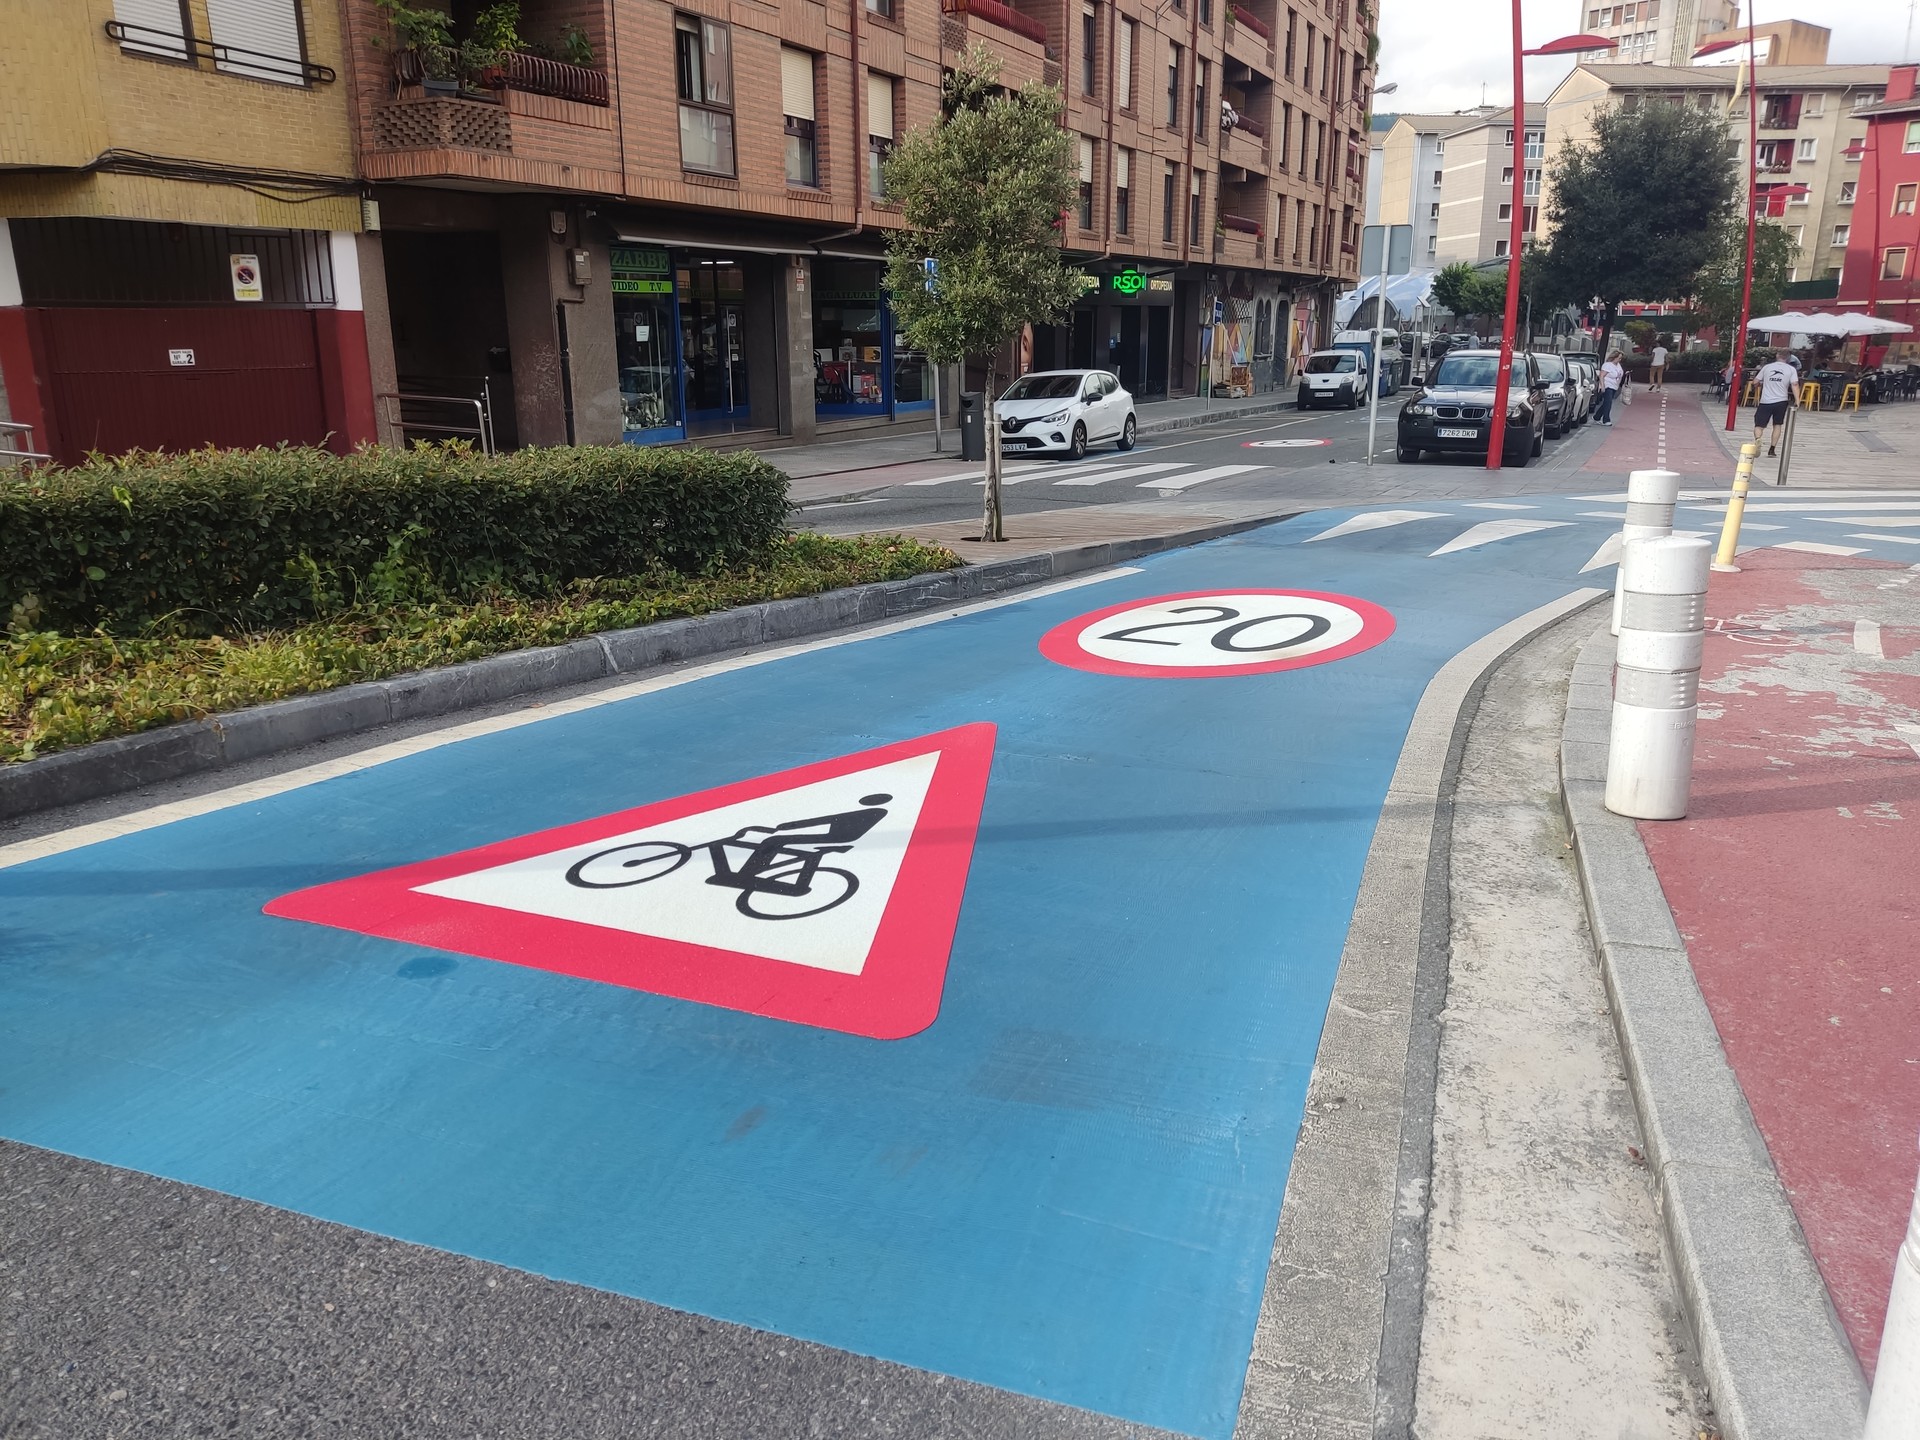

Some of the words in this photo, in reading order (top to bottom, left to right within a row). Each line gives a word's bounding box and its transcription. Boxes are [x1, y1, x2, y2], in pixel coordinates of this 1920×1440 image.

[611, 281, 639, 291] VIDEO
[186, 353, 194, 364] 2
[1098, 605, 1332, 653] 20
